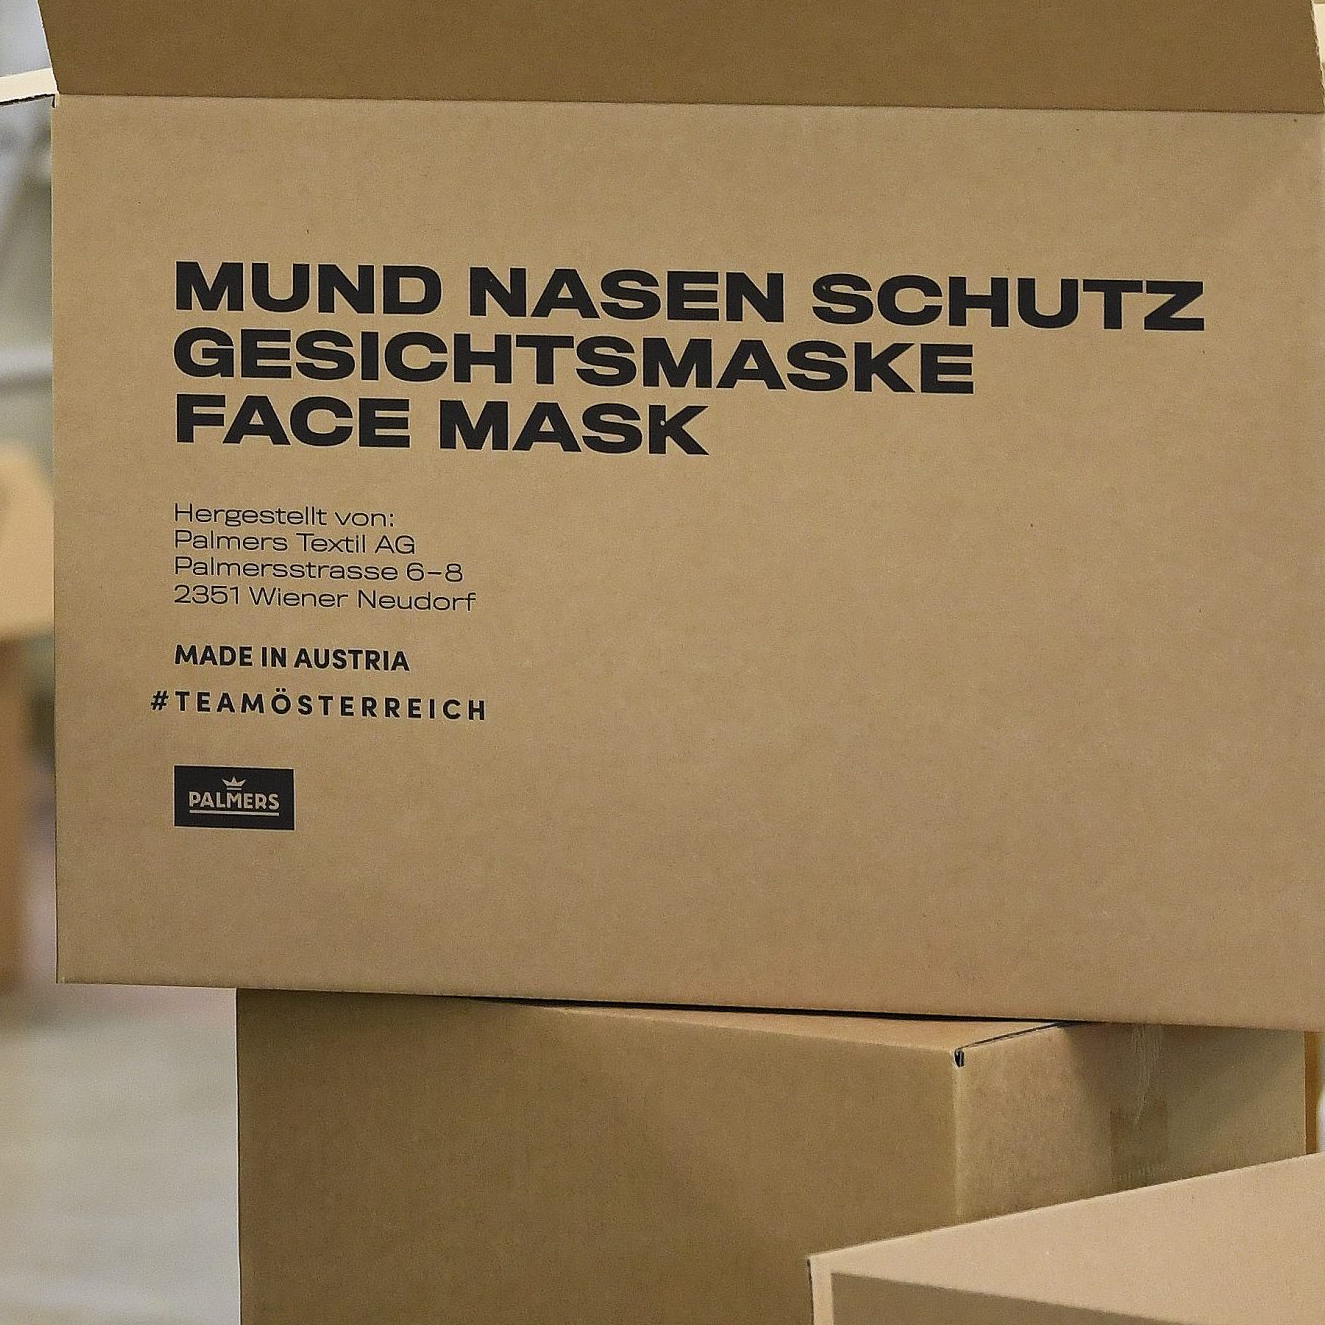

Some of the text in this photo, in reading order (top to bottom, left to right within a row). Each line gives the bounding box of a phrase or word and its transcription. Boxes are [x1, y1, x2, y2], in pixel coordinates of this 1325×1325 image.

[176, 262, 1205, 332] MUND NASEN SCHUTZ
[174, 327, 974, 395] GESICHTSMASKE
[176, 394, 710, 456] FACE MASK
[175, 503, 394, 528] Hergestellt von:
[175, 530, 415, 555] Palmers Textil AG
[175, 557, 399, 581] Palmersstrasse
[175, 585, 477, 612] 2351 Wiener Neudorf
[175, 645, 410, 672] MADE IN AUSTRIA
[150, 687, 485, 721] #TEAMÖSTERREICH
[188, 791, 280, 810] PALMERS
